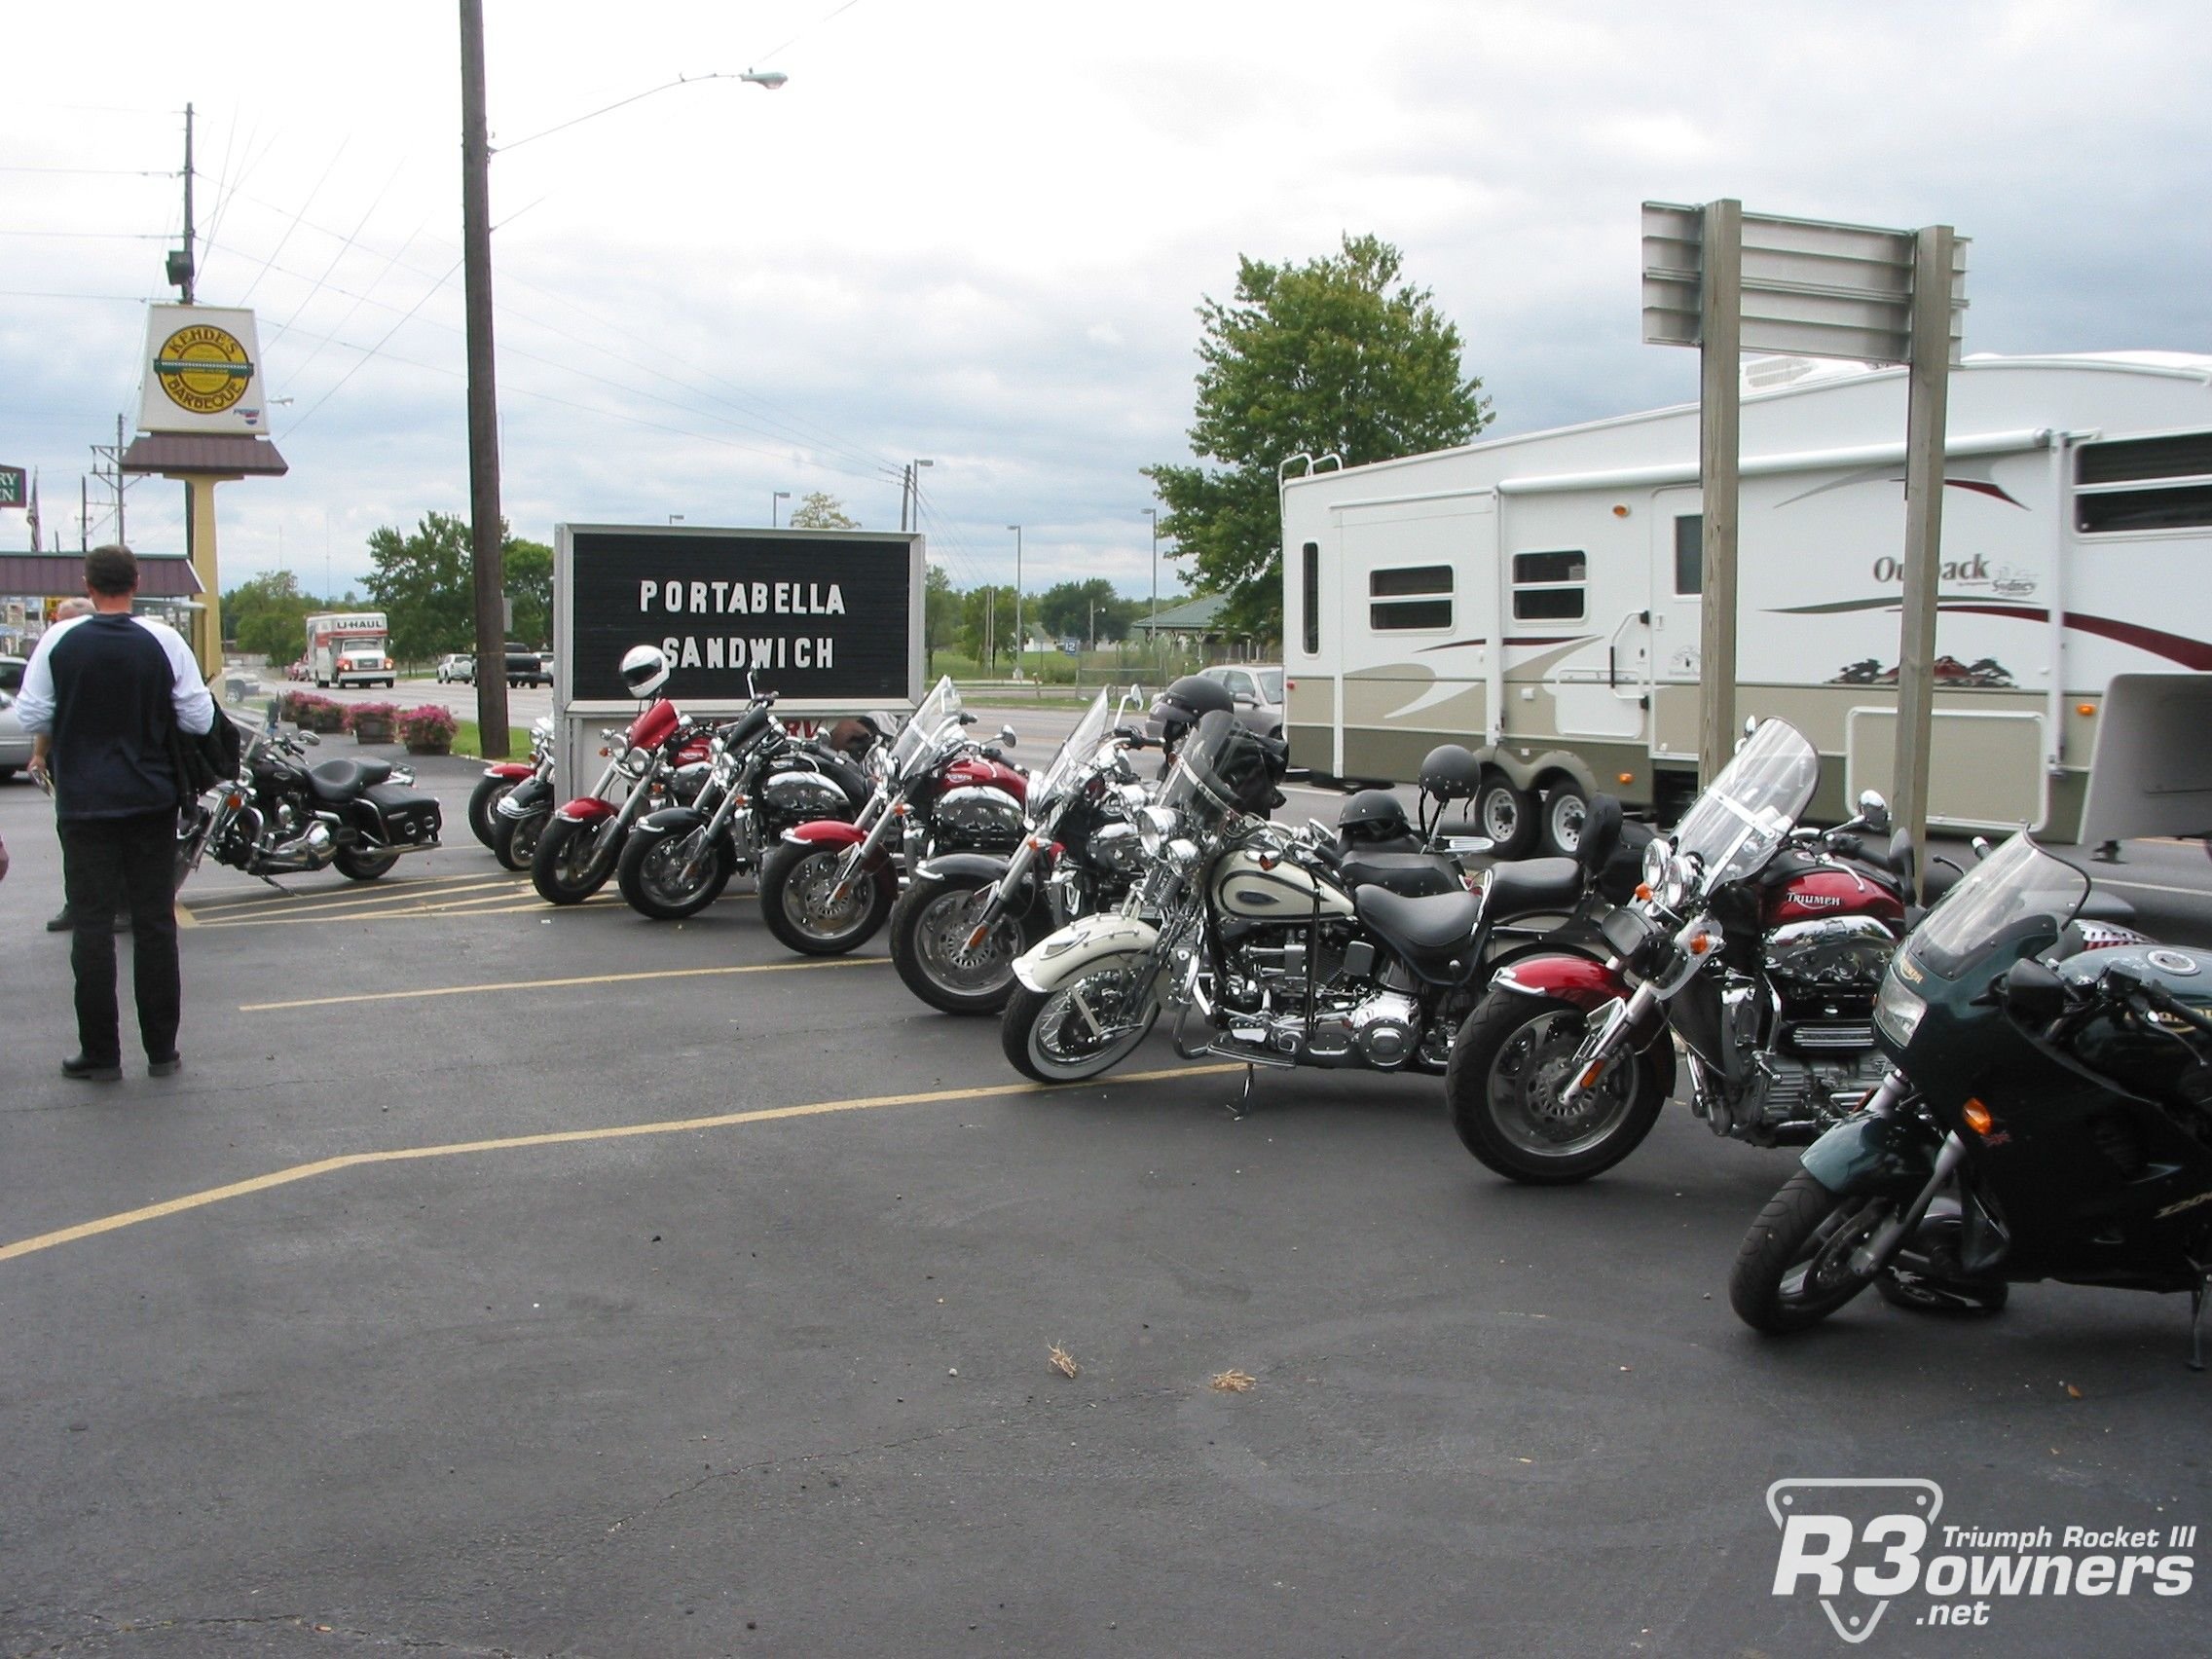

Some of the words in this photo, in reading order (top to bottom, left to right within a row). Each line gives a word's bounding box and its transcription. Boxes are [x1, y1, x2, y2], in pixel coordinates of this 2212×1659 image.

[167, 380, 242, 409] BARBEQUE
[640, 580, 846, 614] PORTABELLA
[337, 620, 382, 630] U-HAUL
[662, 636, 833, 669] SANDWICH
[1787, 892, 1840, 907] TRIUMPH
